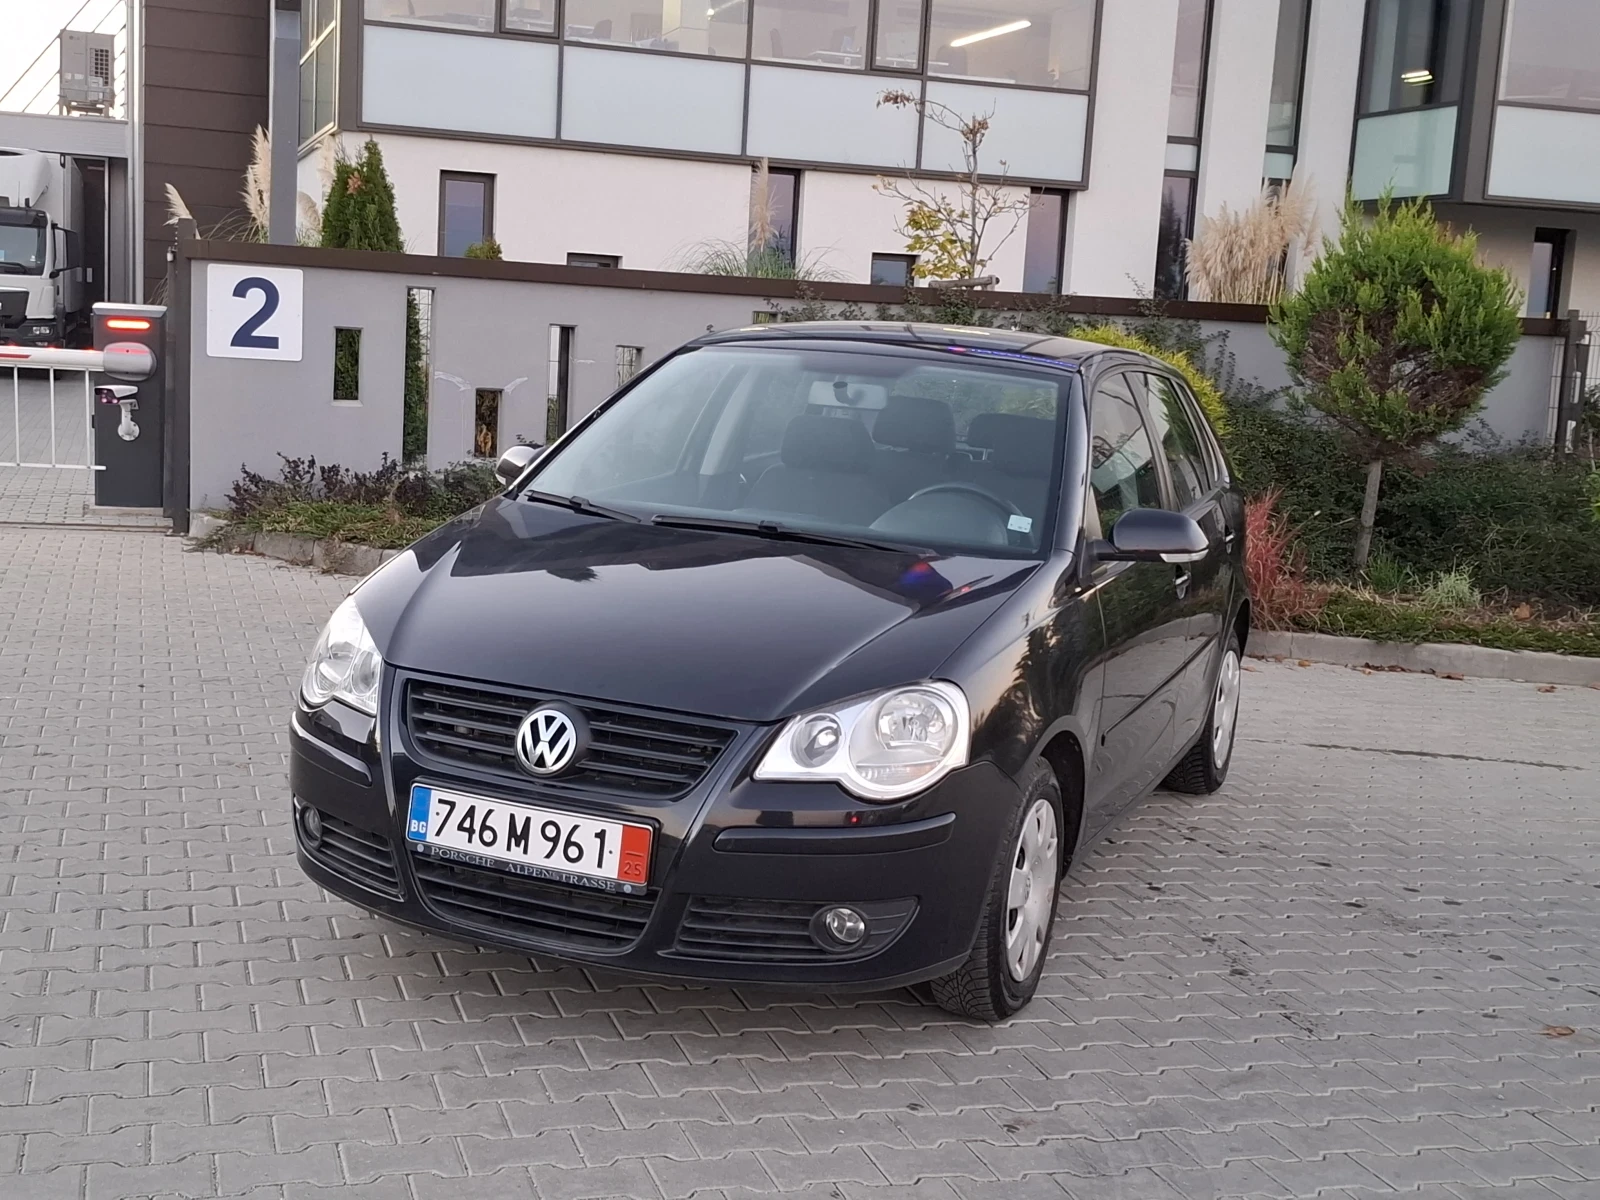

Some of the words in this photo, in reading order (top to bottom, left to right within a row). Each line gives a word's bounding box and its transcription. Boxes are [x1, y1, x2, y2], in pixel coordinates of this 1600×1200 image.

[229, 276, 280, 350] 2
[517, 709, 577, 774] VW
[410, 820, 427, 834] BG
[434, 798, 498, 847] 746
[506, 813, 532, 855] M
[540, 820, 607, 869] 961
[430, 846, 496, 867] PORSCHE
[624, 861, 643, 877] 25
